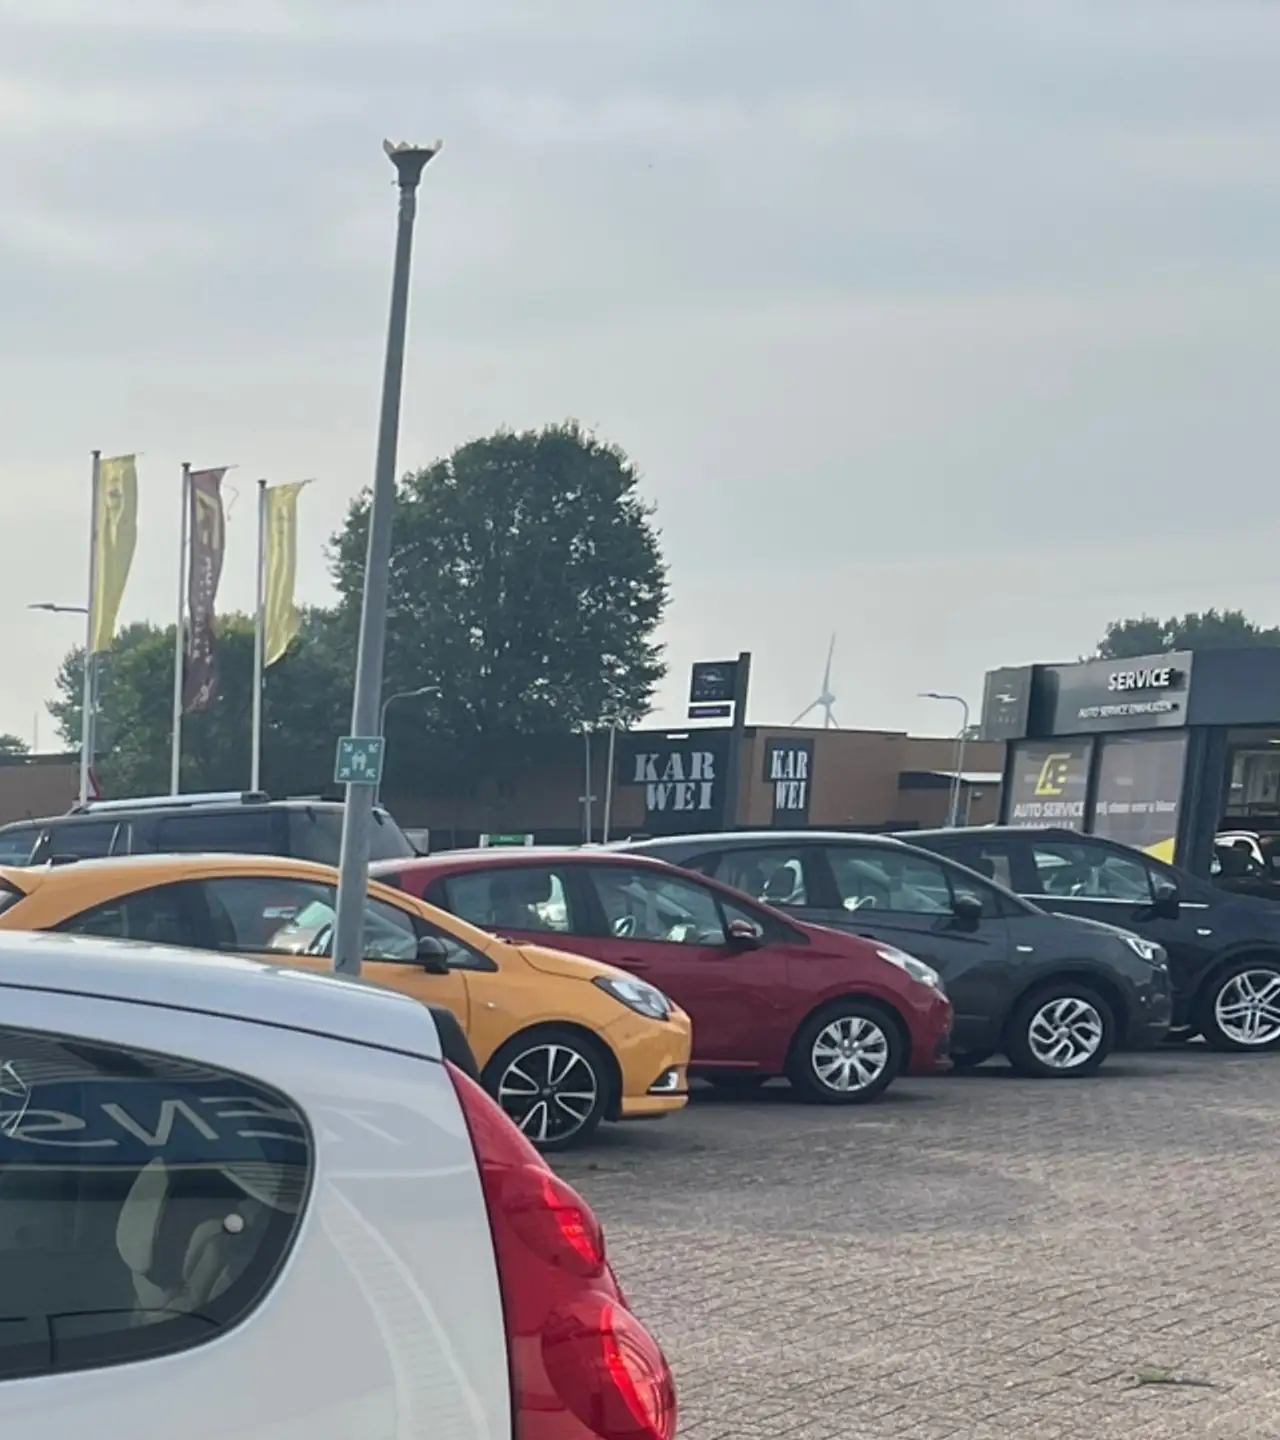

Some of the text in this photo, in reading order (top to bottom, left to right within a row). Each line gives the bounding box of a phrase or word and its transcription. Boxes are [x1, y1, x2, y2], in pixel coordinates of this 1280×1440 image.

[1108, 667, 1170, 691] SERVICE
[634, 752, 716, 782] KAR
[771, 750, 808, 779] KAR
[646, 782, 713, 811] WEI
[776, 780, 807, 810] WEI
[1014, 803, 1040, 818] AUTO
[1042, 802, 1084, 817] SERVICE
